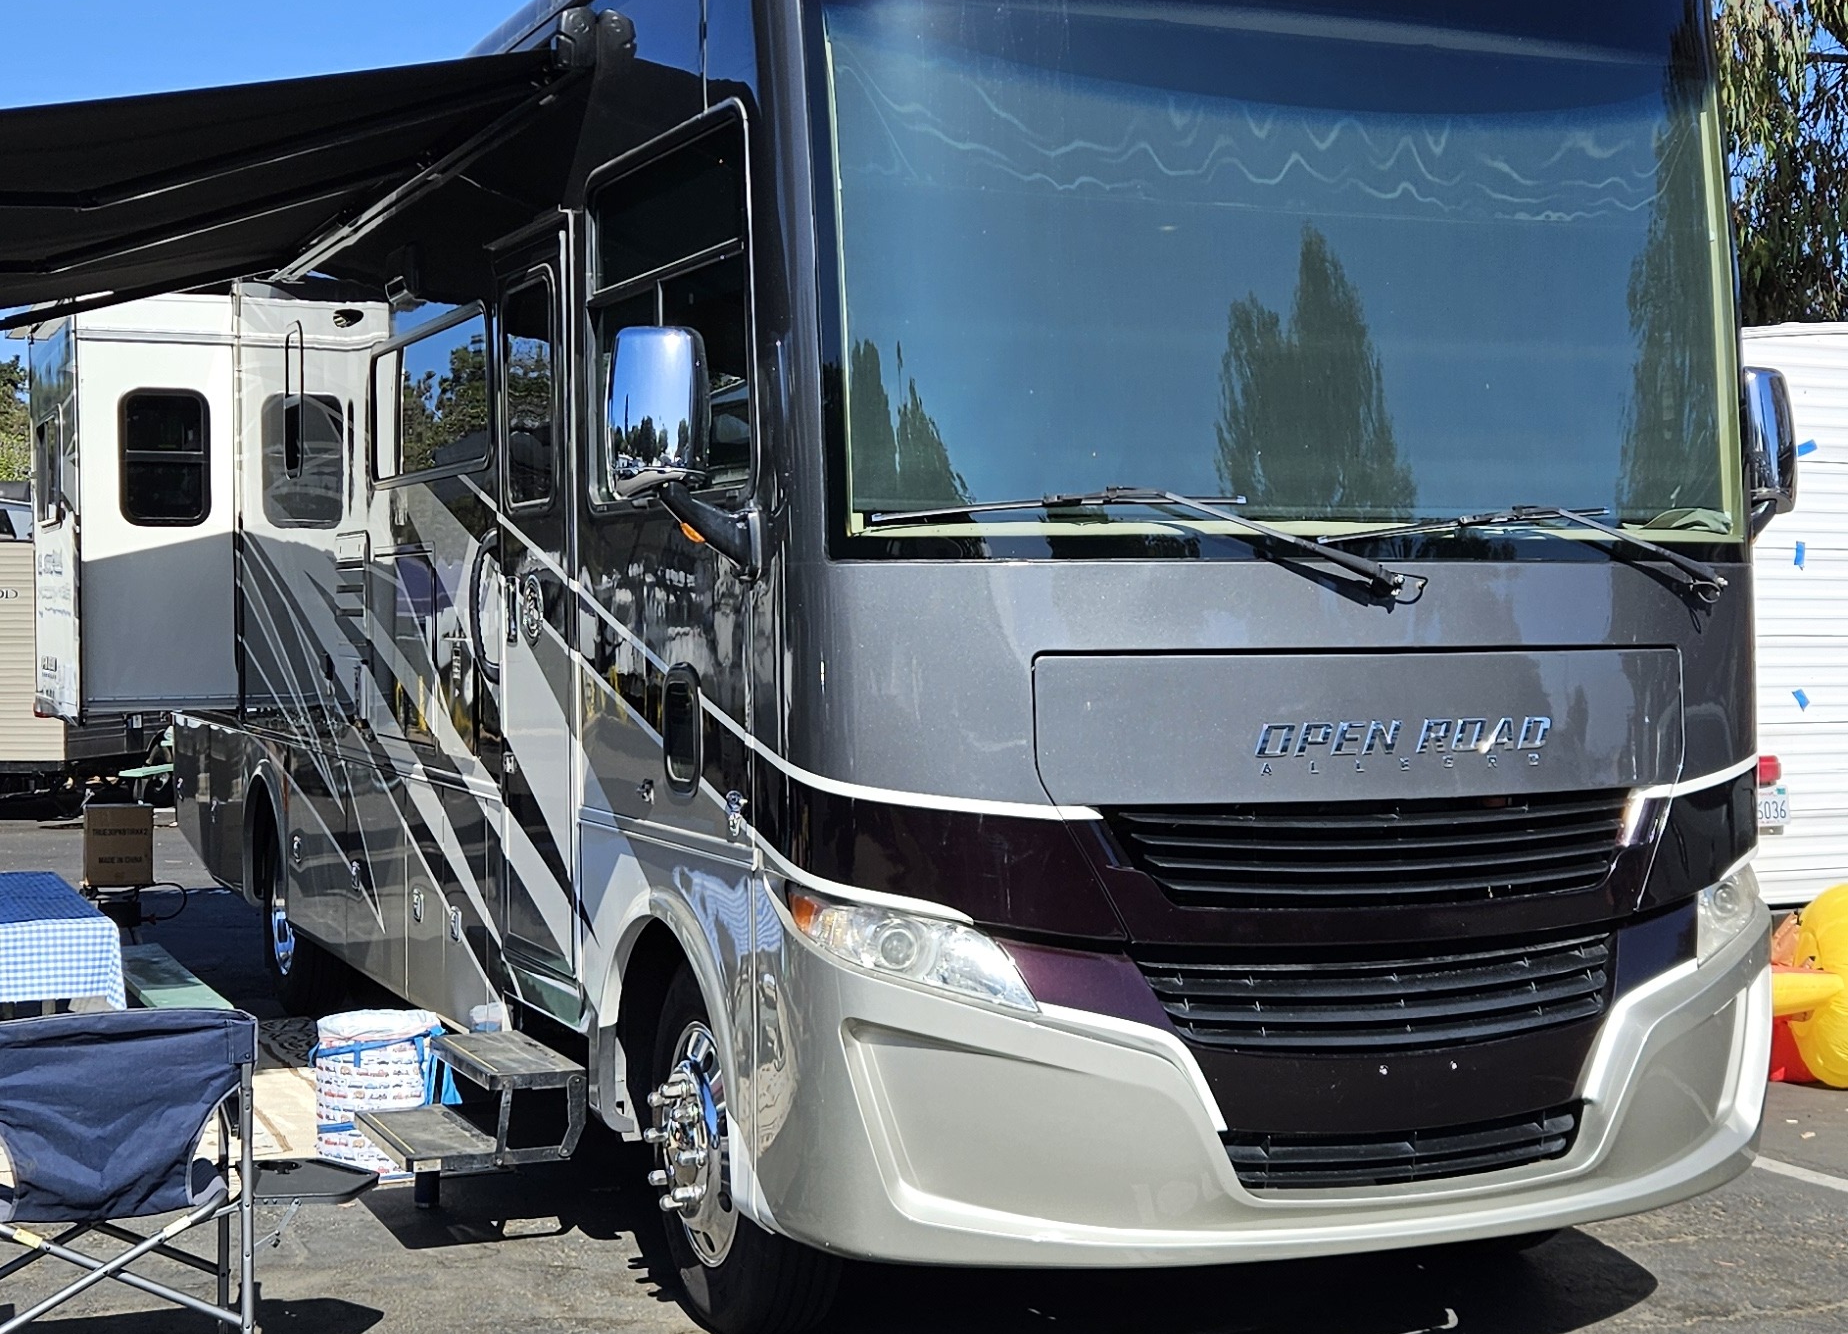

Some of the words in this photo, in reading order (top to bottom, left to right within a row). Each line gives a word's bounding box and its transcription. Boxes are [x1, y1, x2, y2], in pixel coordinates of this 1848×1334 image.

[1255, 719, 1402, 758] OPEN
[1415, 715, 1552, 754] ROAD
[1260, 753, 1540, 776] ALLEGRO
